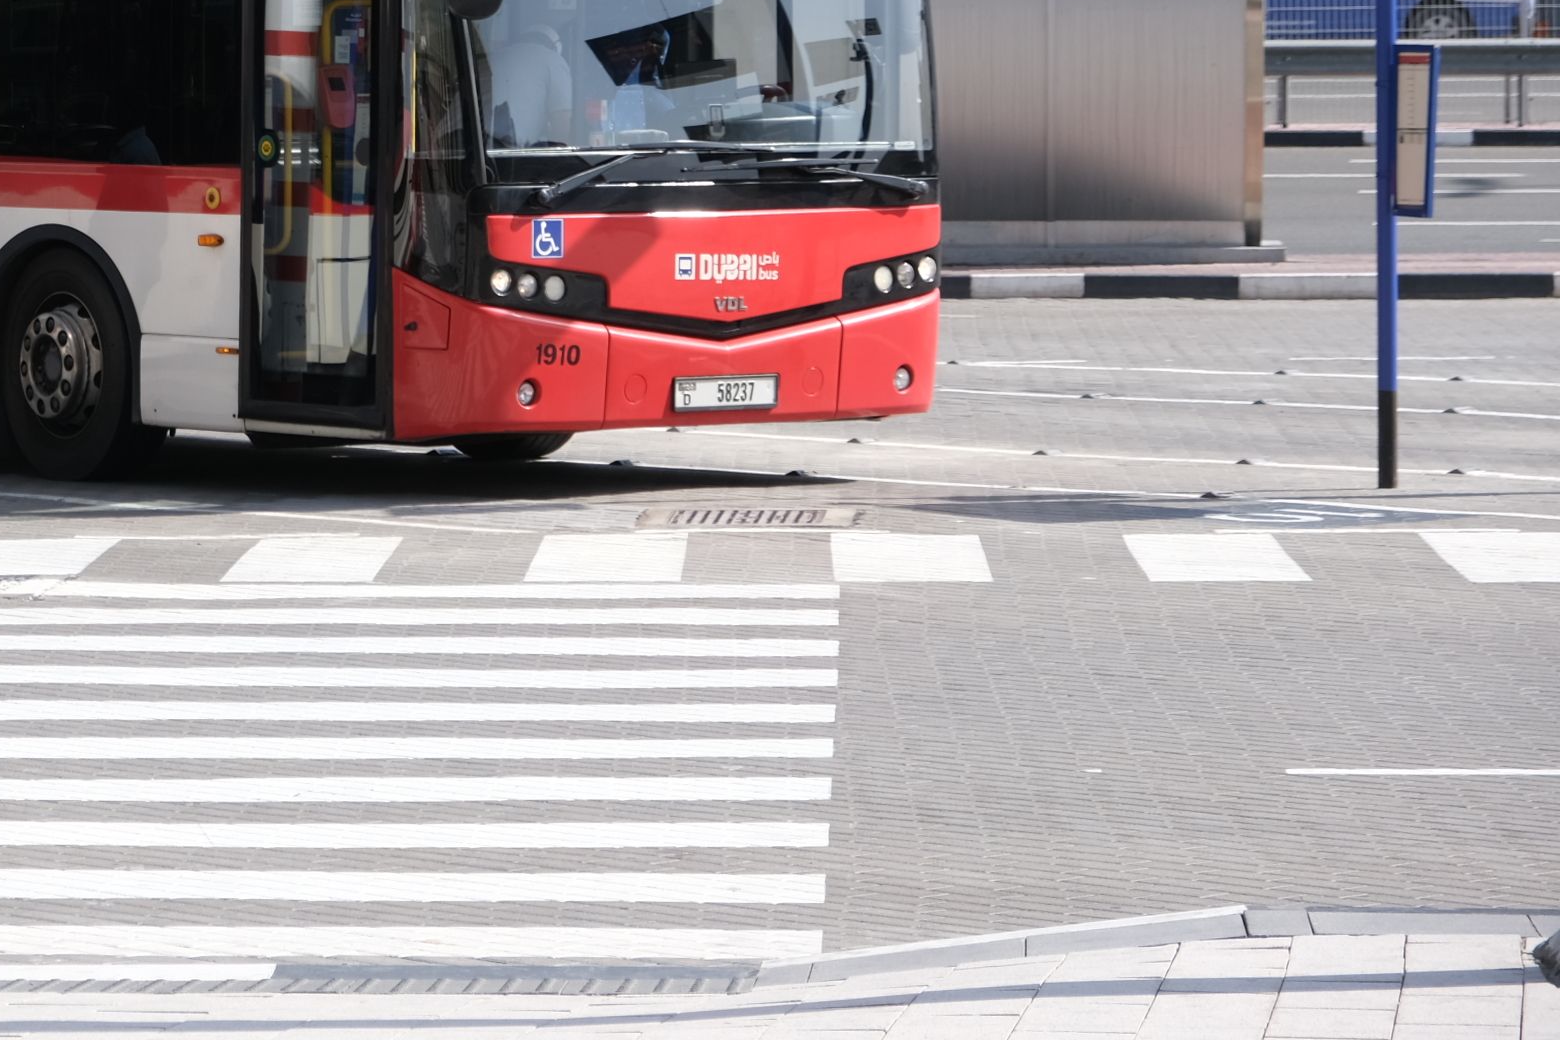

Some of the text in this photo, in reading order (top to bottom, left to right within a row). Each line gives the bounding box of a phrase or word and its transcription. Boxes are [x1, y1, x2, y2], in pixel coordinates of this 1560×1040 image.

[699, 253, 757, 284] DUBAI
[758, 268, 779, 280] bus
[714, 296, 748, 312] VDL
[536, 343, 581, 366] 1910
[683, 393, 691, 406] D
[717, 381, 755, 403] 58237
